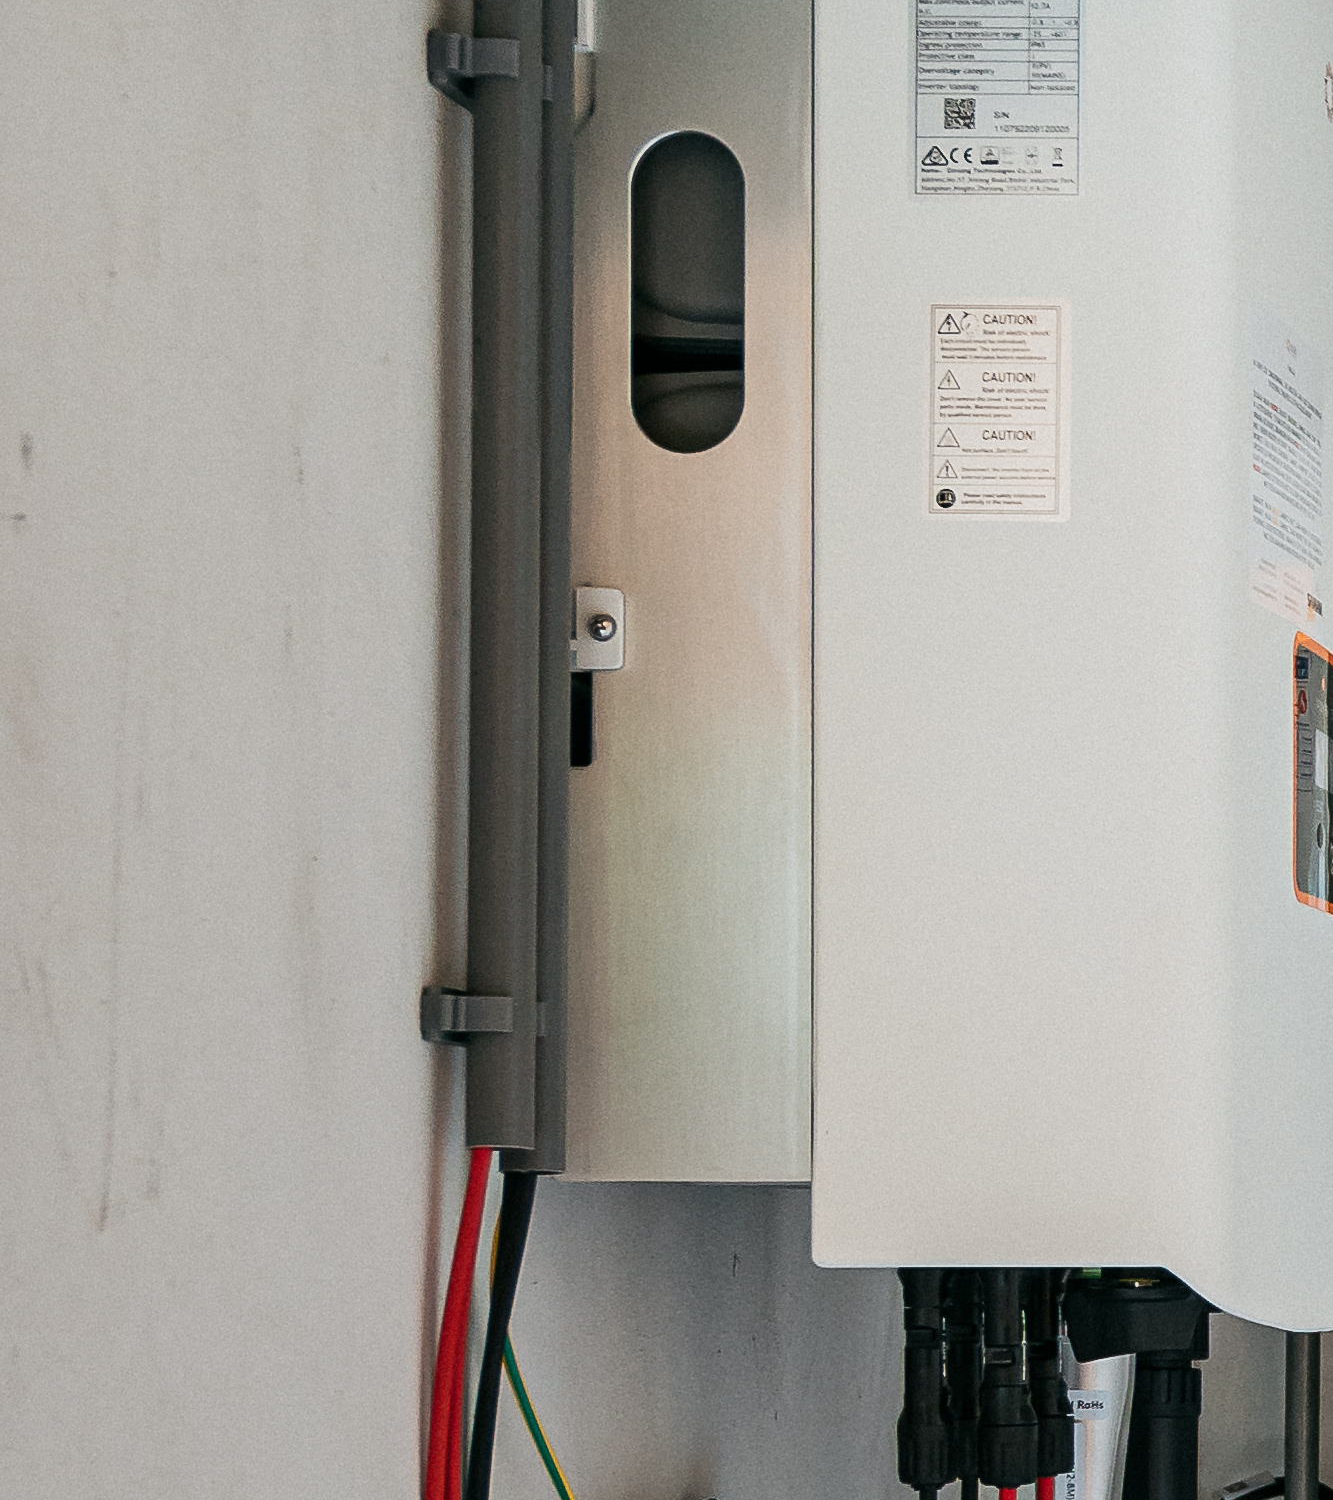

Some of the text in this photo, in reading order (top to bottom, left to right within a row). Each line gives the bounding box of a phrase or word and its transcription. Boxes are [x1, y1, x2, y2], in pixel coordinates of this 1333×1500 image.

[982, 313, 1038, 325] CAUTION!
[981, 371, 1037, 383] CAUTION!
[981, 429, 1037, 441] CAUTION!
